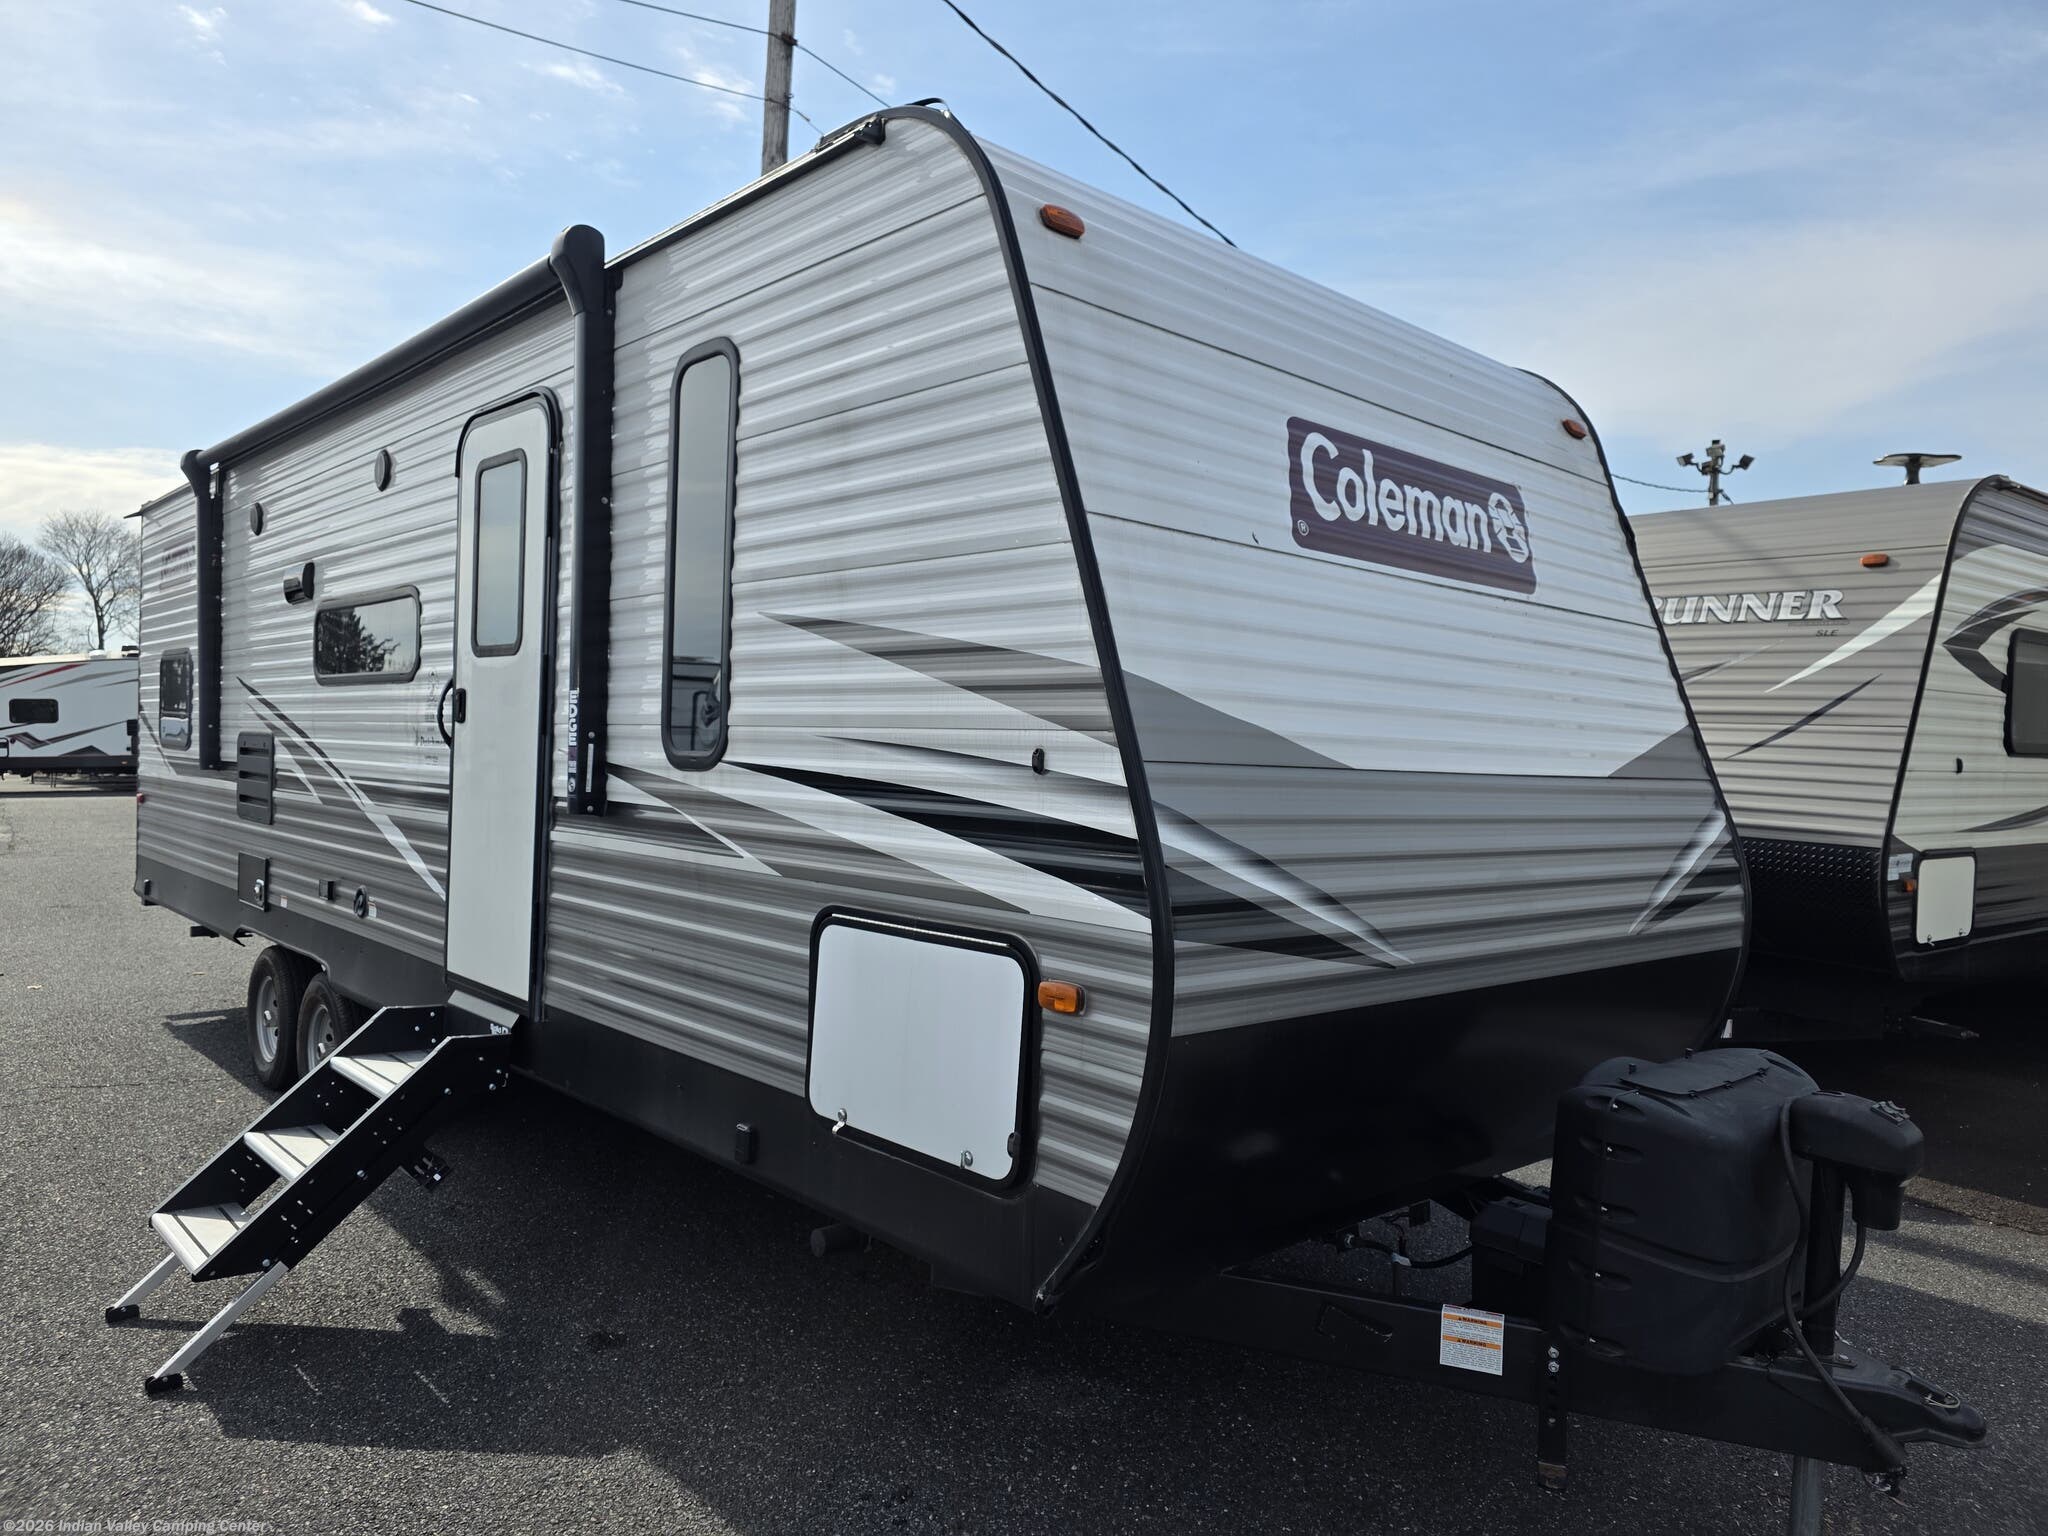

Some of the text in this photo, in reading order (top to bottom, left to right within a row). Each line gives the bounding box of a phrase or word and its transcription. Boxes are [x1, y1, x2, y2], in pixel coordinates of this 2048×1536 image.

[1301, 432, 1492, 553] Coleman
[1815, 629, 1839, 637] SLE
[1462, 1316, 1487, 1325] WARNING
[1461, 1339, 1487, 1347] WARNING
